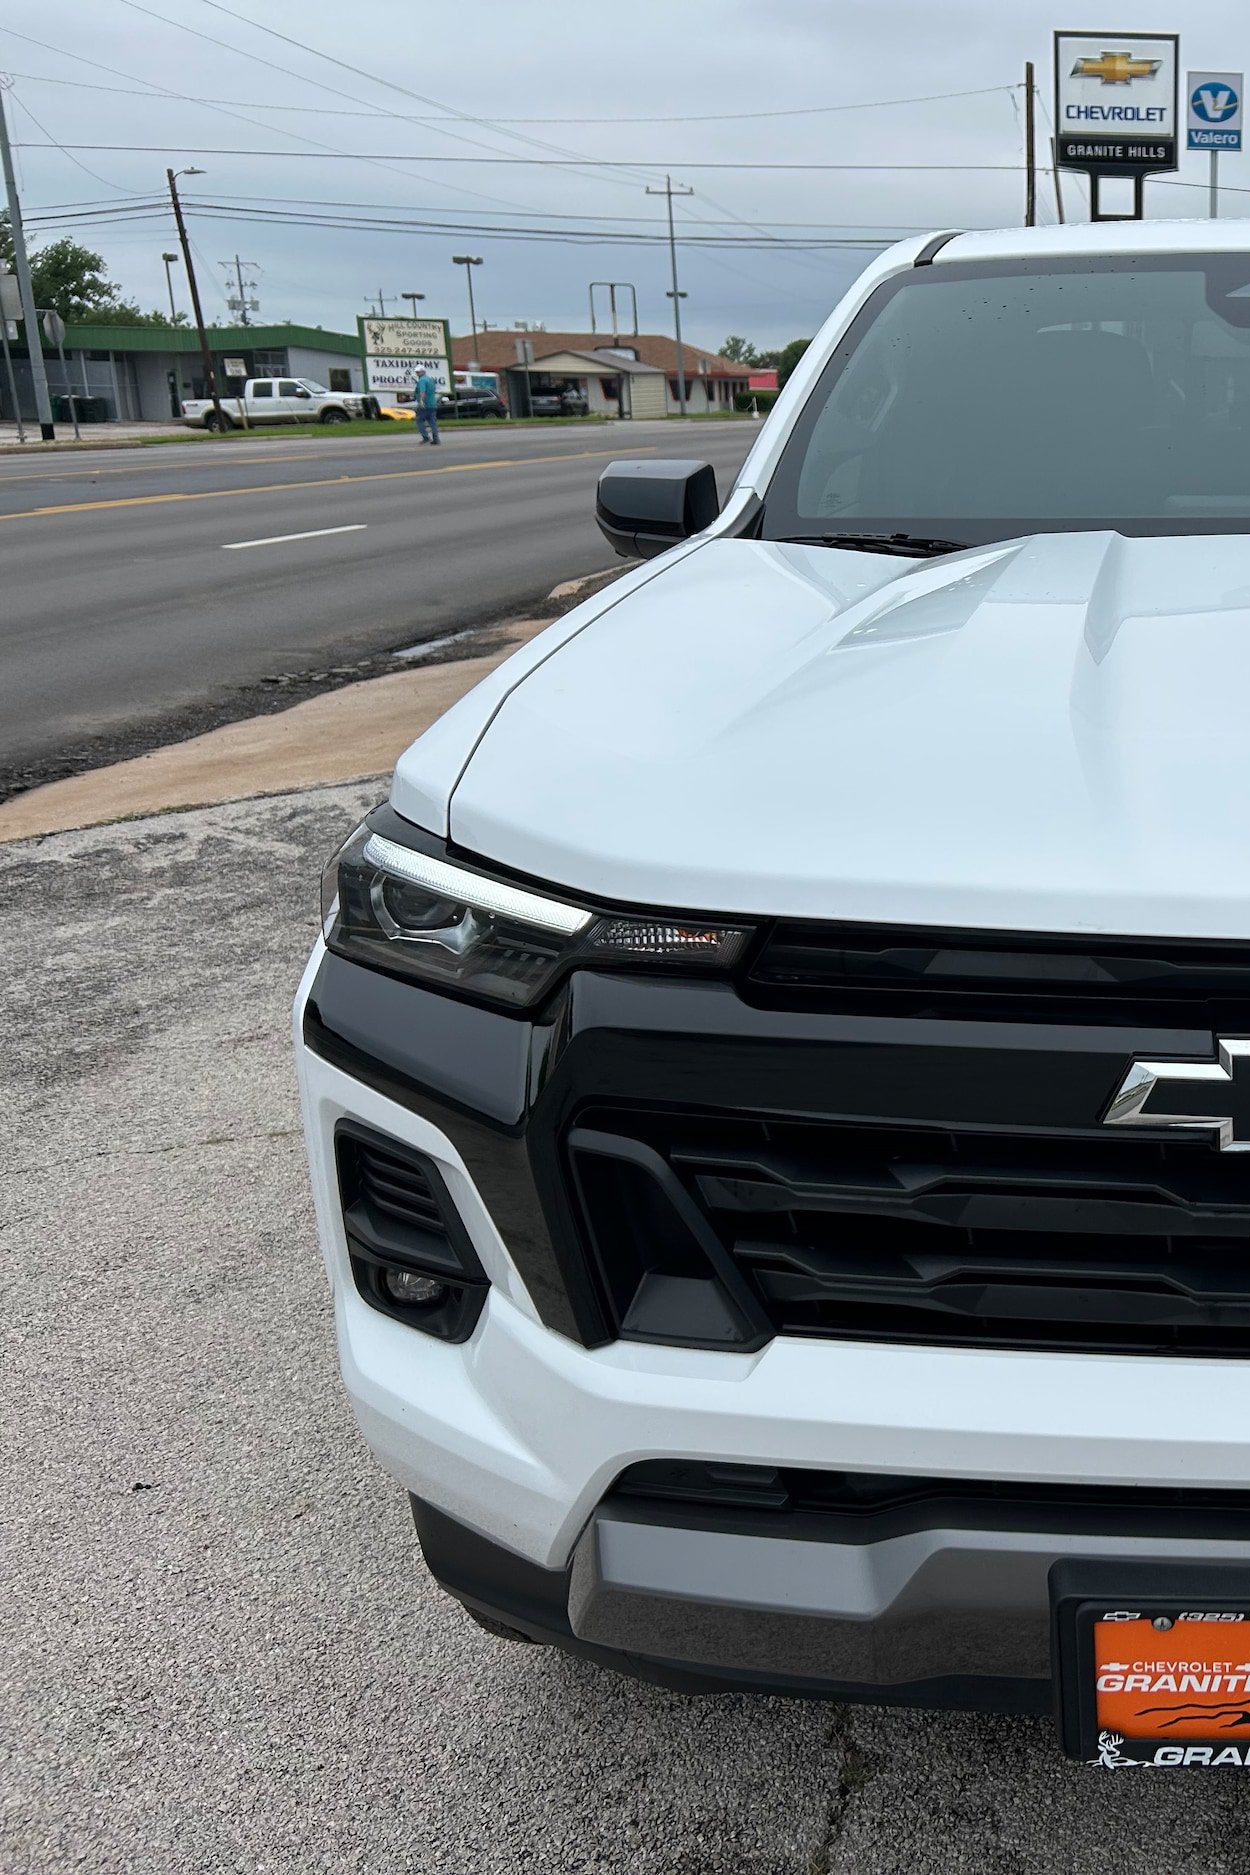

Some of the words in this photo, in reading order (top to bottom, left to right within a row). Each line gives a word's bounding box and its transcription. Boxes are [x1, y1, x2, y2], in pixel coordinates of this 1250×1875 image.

[1066, 104, 1167, 122] CHEVROLET
[1190, 131, 1239, 145] Valero
[1067, 144, 1124, 158] GRANITE
[1128, 145, 1166, 159] HILLS
[406, 321, 442, 332] COUNTRY
[396, 330, 438, 338] SPORTING
[402, 338, 433, 346] GOODS
[372, 375, 446, 385] PROCESNG
[1132, 1661, 1233, 1673] CHEVROLET
